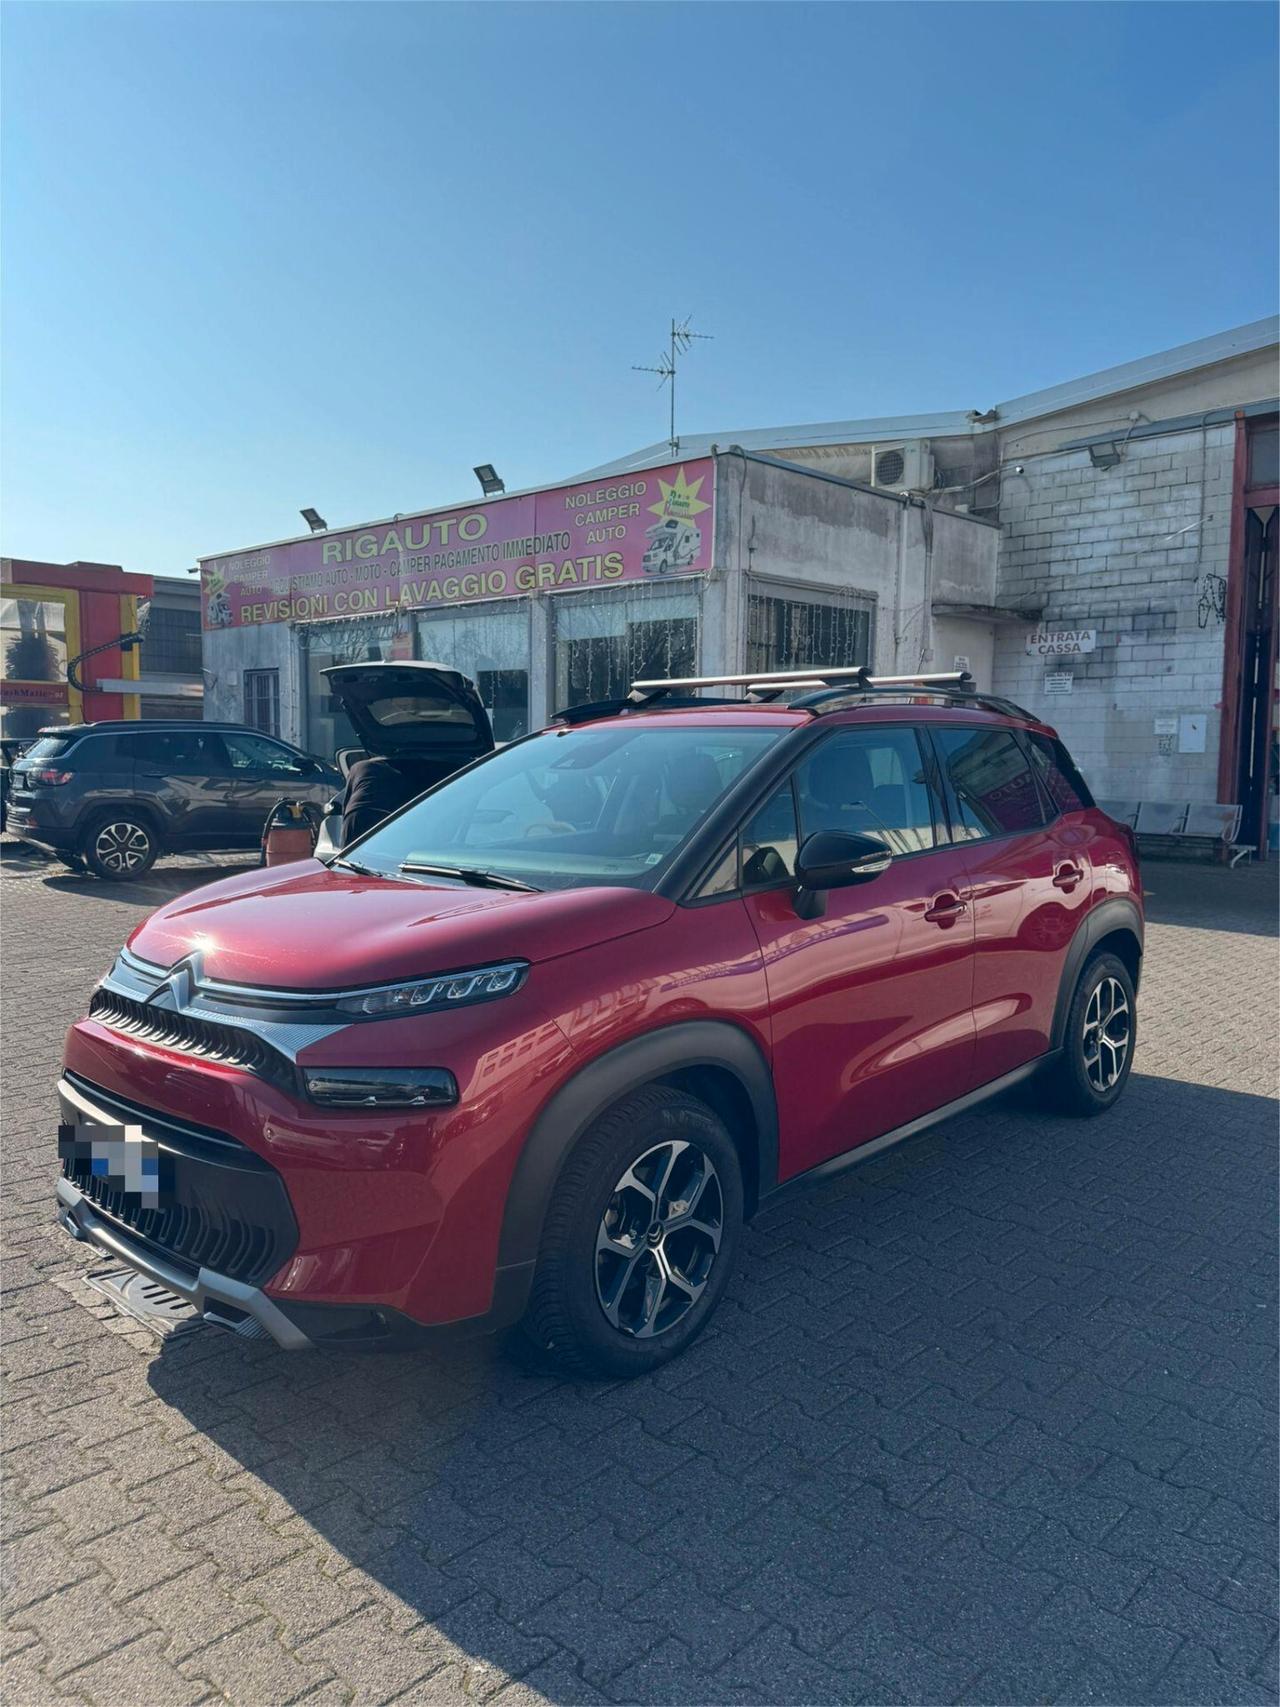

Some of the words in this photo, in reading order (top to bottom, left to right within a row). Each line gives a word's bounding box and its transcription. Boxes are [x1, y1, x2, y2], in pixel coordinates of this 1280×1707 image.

[565, 481, 647, 509] NOLEGGIO
[575, 503, 640, 527] CAMPER
[322, 513, 488, 565] RIGAUTO
[586, 525, 626, 545] AUTO
[326, 567, 349, 585] AUTO
[355, 563, 381, 582] MOTO
[389, 555, 431, 577] CAMPER
[434, 542, 500, 573] PAGAMENTO
[503, 532, 571, 561] IMMEDIATO
[240, 595, 328, 622] REVISIONI
[334, 587, 378, 612] CON
[385, 569, 507, 607] LAVAGGIO
[514, 552, 624, 591] GRATIS
[1030, 630, 1091, 645] ENTRATA
[1038, 643, 1081, 655] CASSA
